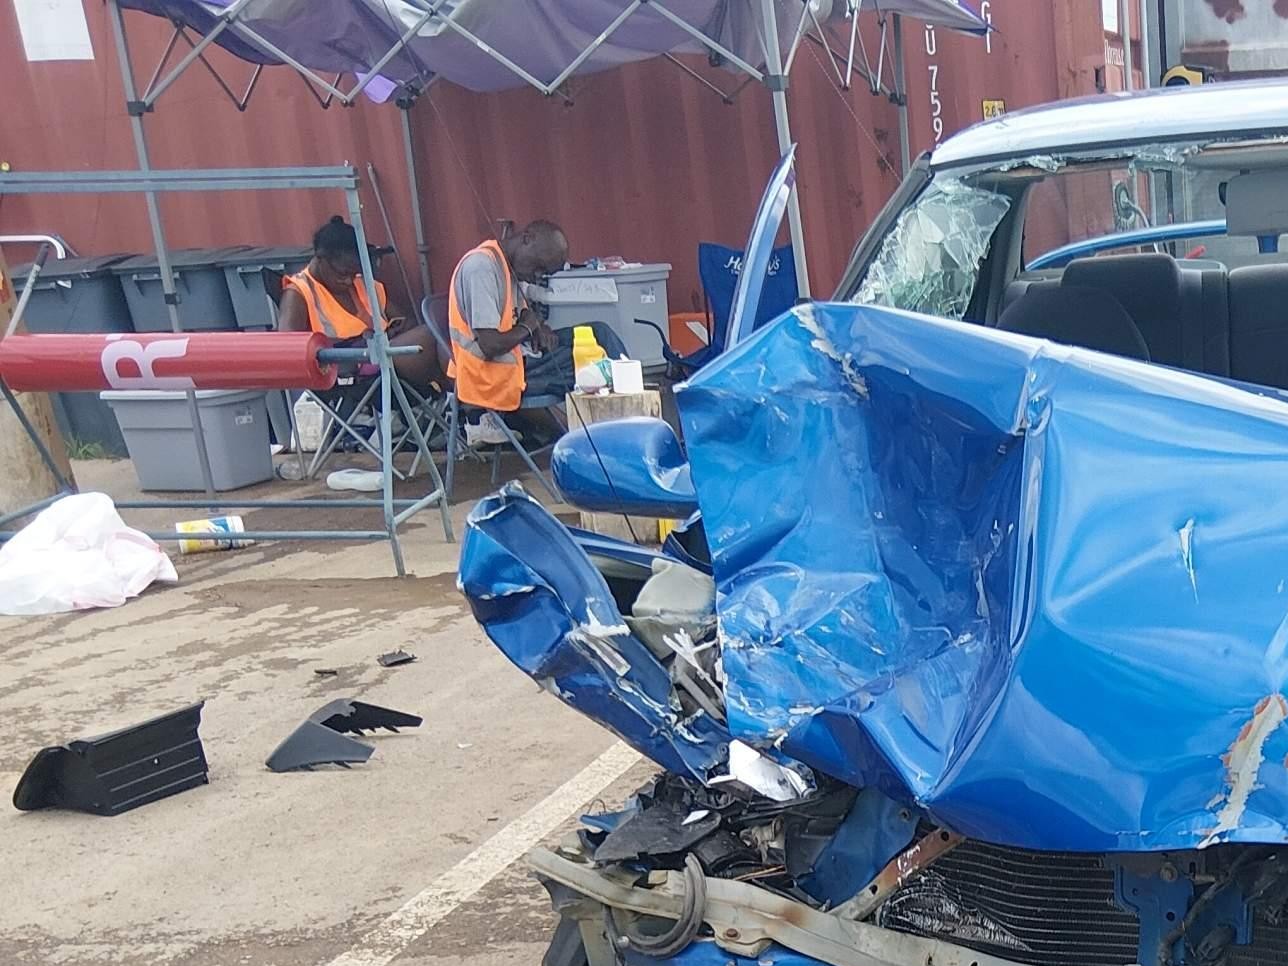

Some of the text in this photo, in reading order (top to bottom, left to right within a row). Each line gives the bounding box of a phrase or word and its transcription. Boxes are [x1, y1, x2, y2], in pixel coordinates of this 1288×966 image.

[925, 24, 943, 149] U 759
[101, 333, 198, 390] R
